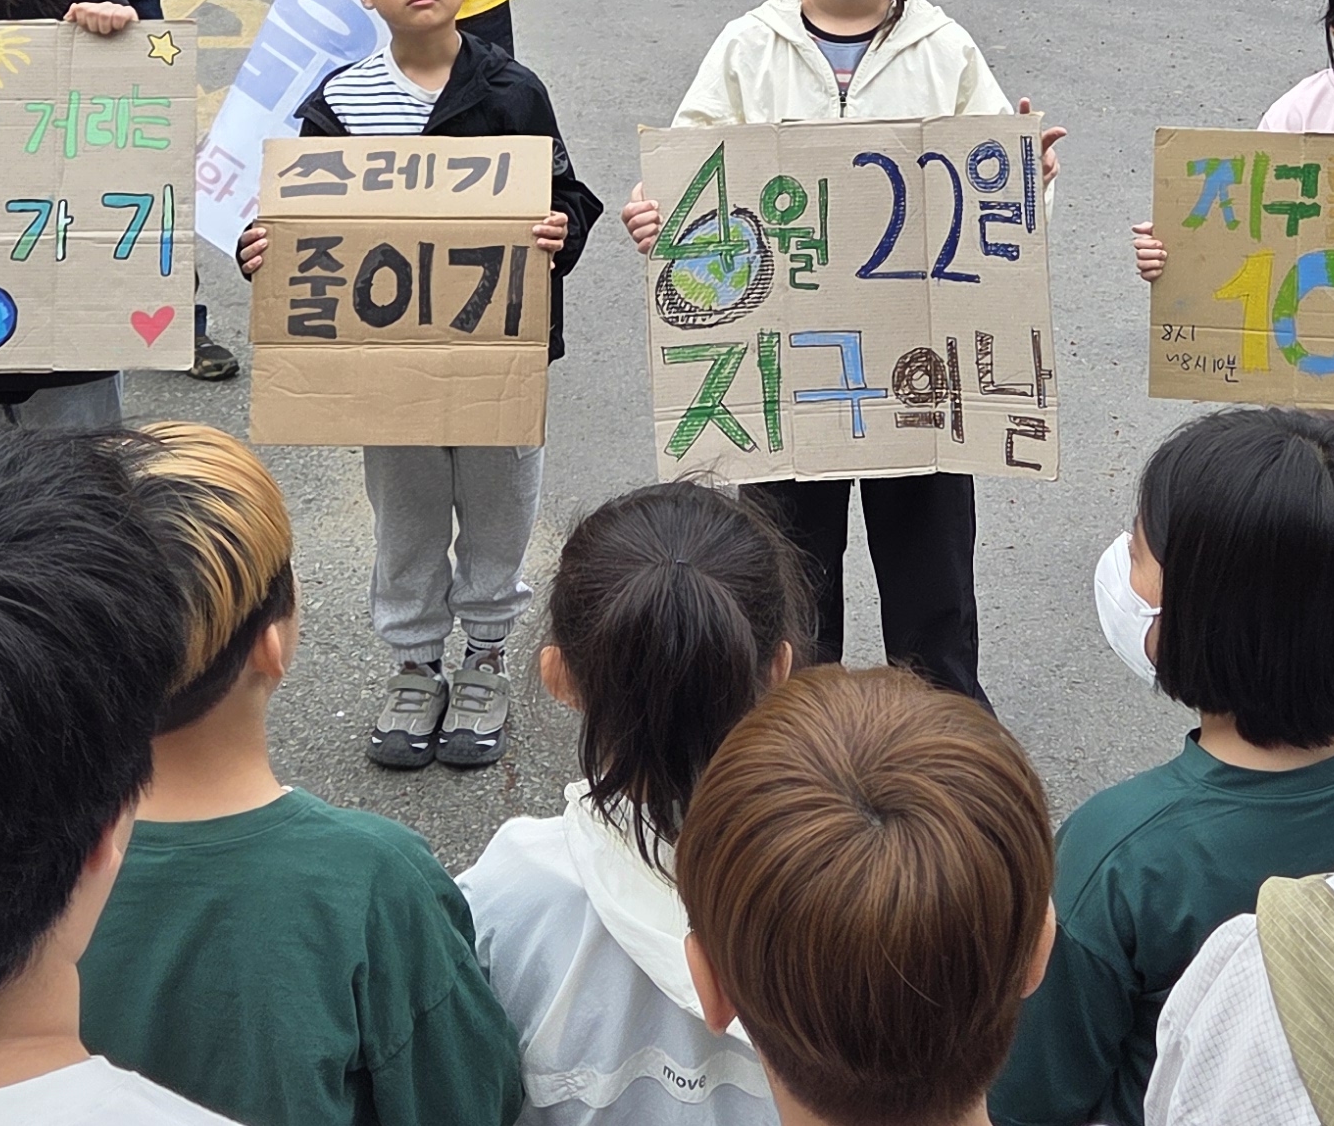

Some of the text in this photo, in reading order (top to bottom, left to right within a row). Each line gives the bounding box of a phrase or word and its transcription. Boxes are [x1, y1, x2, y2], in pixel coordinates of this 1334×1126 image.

[277, 149, 513, 200] 쓰레기
[649, 134, 1038, 291] 4월 22일
[286, 234, 530, 339] 줄이기
[1161, 323, 1196, 343] 8시
[662, 1065, 708, 1091] move
